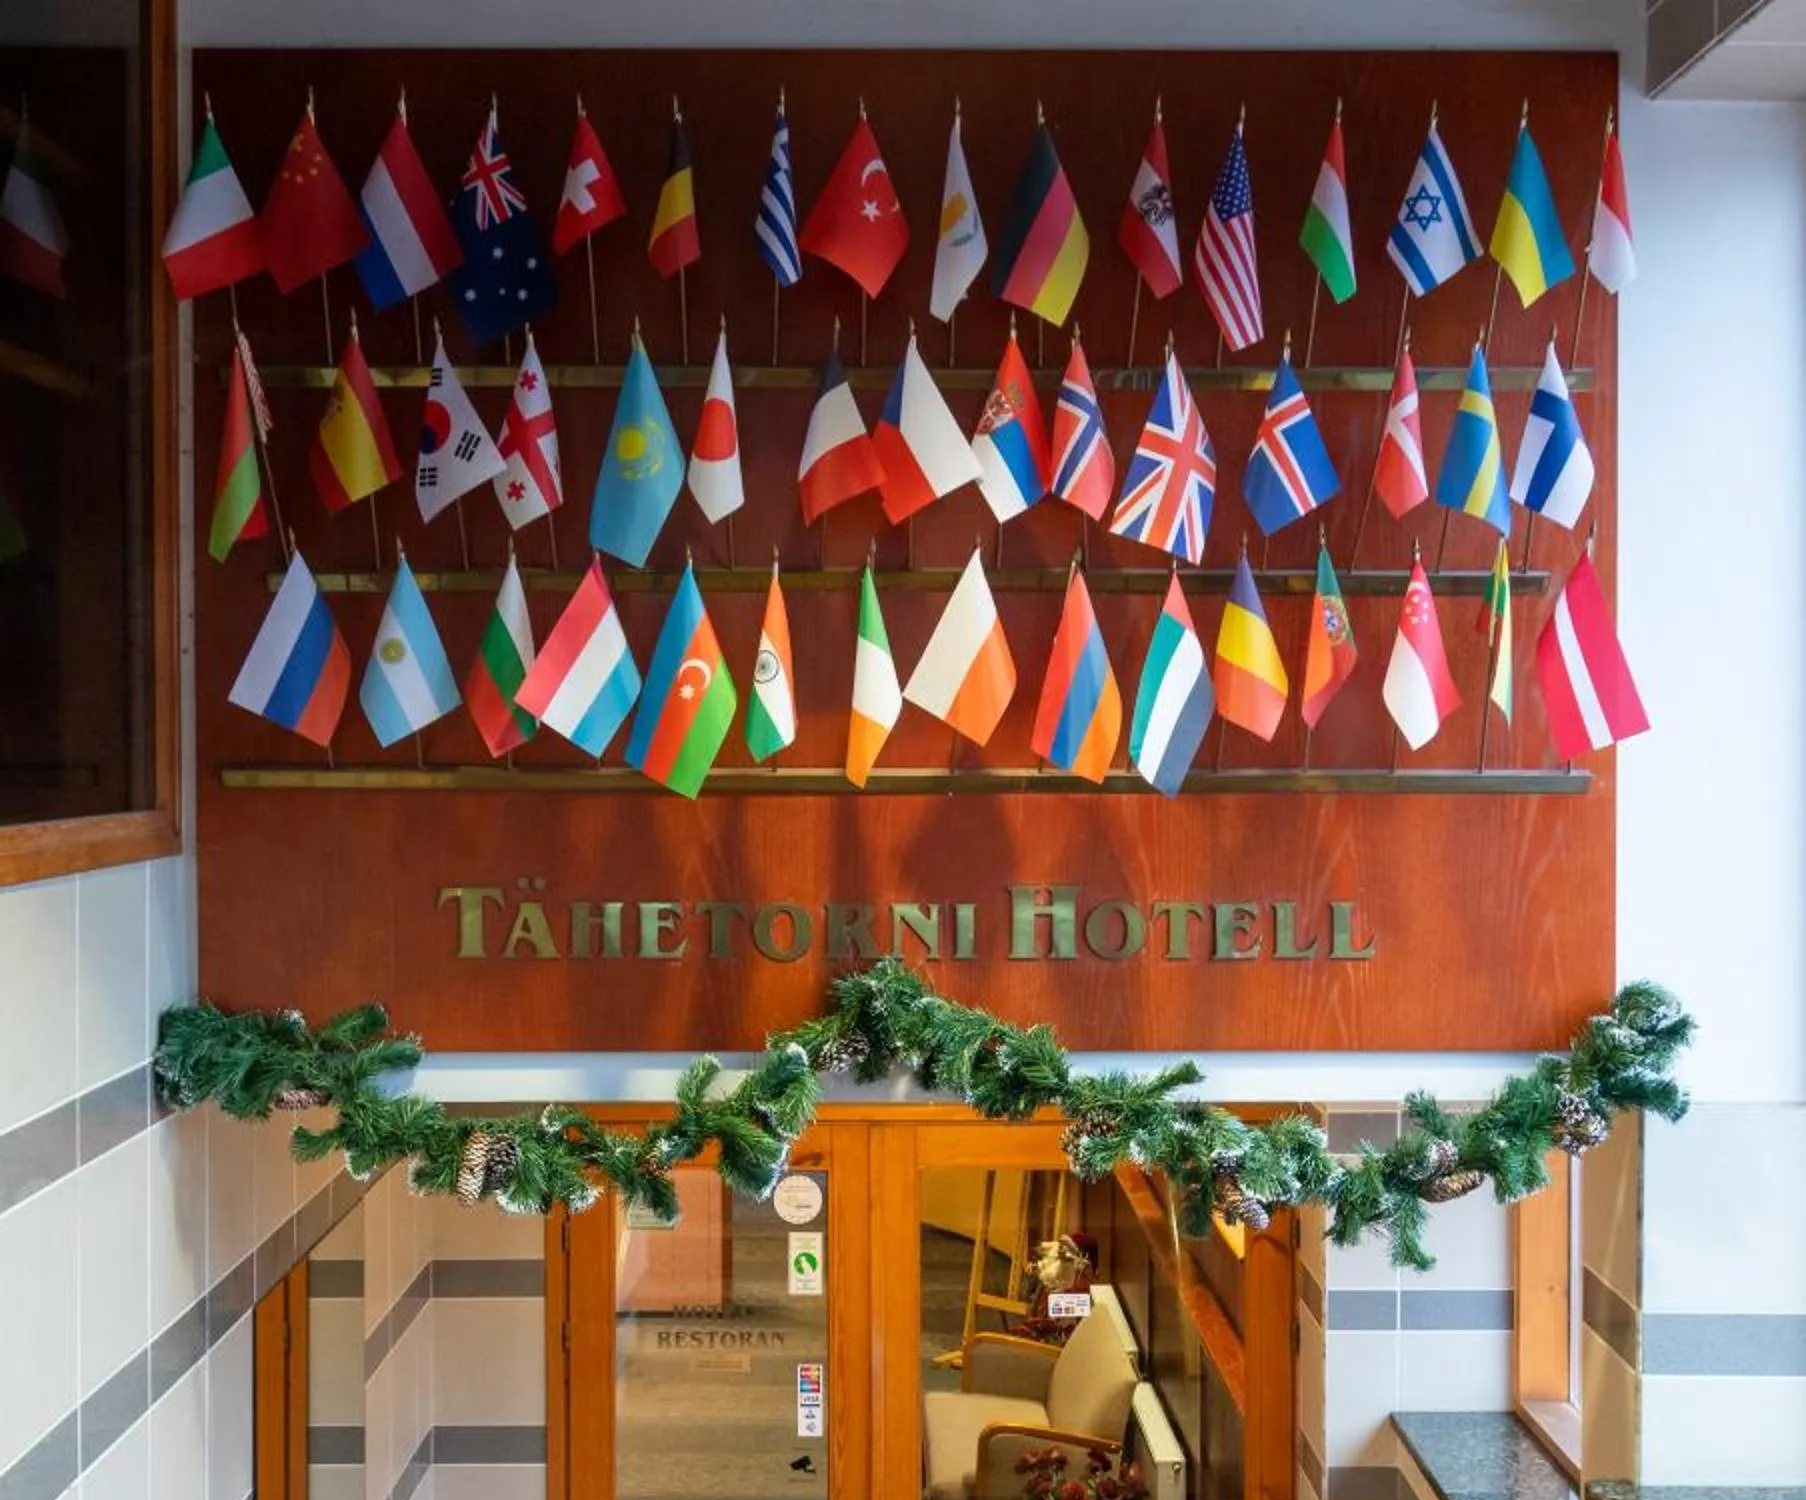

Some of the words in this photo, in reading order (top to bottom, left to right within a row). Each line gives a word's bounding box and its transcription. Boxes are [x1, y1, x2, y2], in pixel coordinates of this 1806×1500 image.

[436, 876, 977, 962] TÄHETORNI
[1006, 883, 1376, 961] HOTELL
[656, 1330, 786, 1350] RESTORAN
